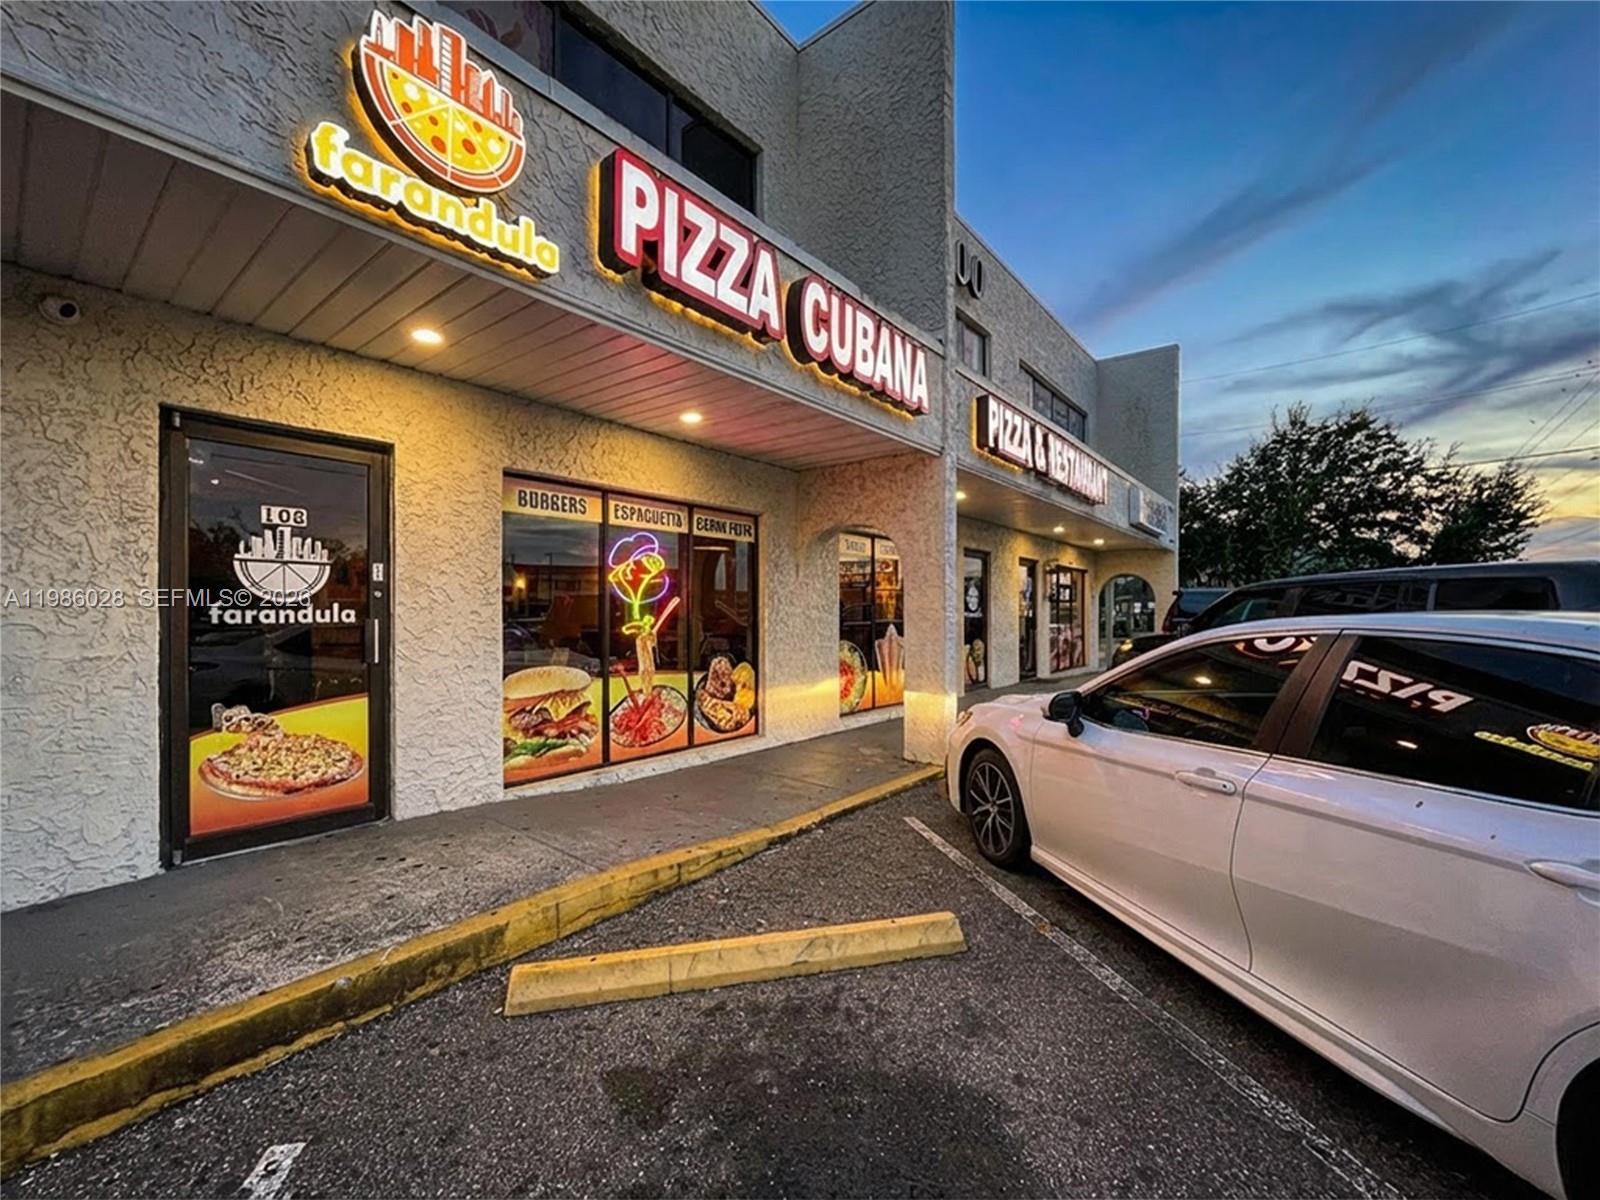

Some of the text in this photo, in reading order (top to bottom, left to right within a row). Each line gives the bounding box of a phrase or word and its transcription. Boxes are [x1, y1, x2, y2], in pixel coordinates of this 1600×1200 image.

[312, 121, 560, 275] farandula
[619, 159, 930, 411] PIZZA CUBANA
[988, 396, 1034, 467] PIZZA
[1034, 425, 1047, 472] &
[208, 600, 357, 625] farandula
